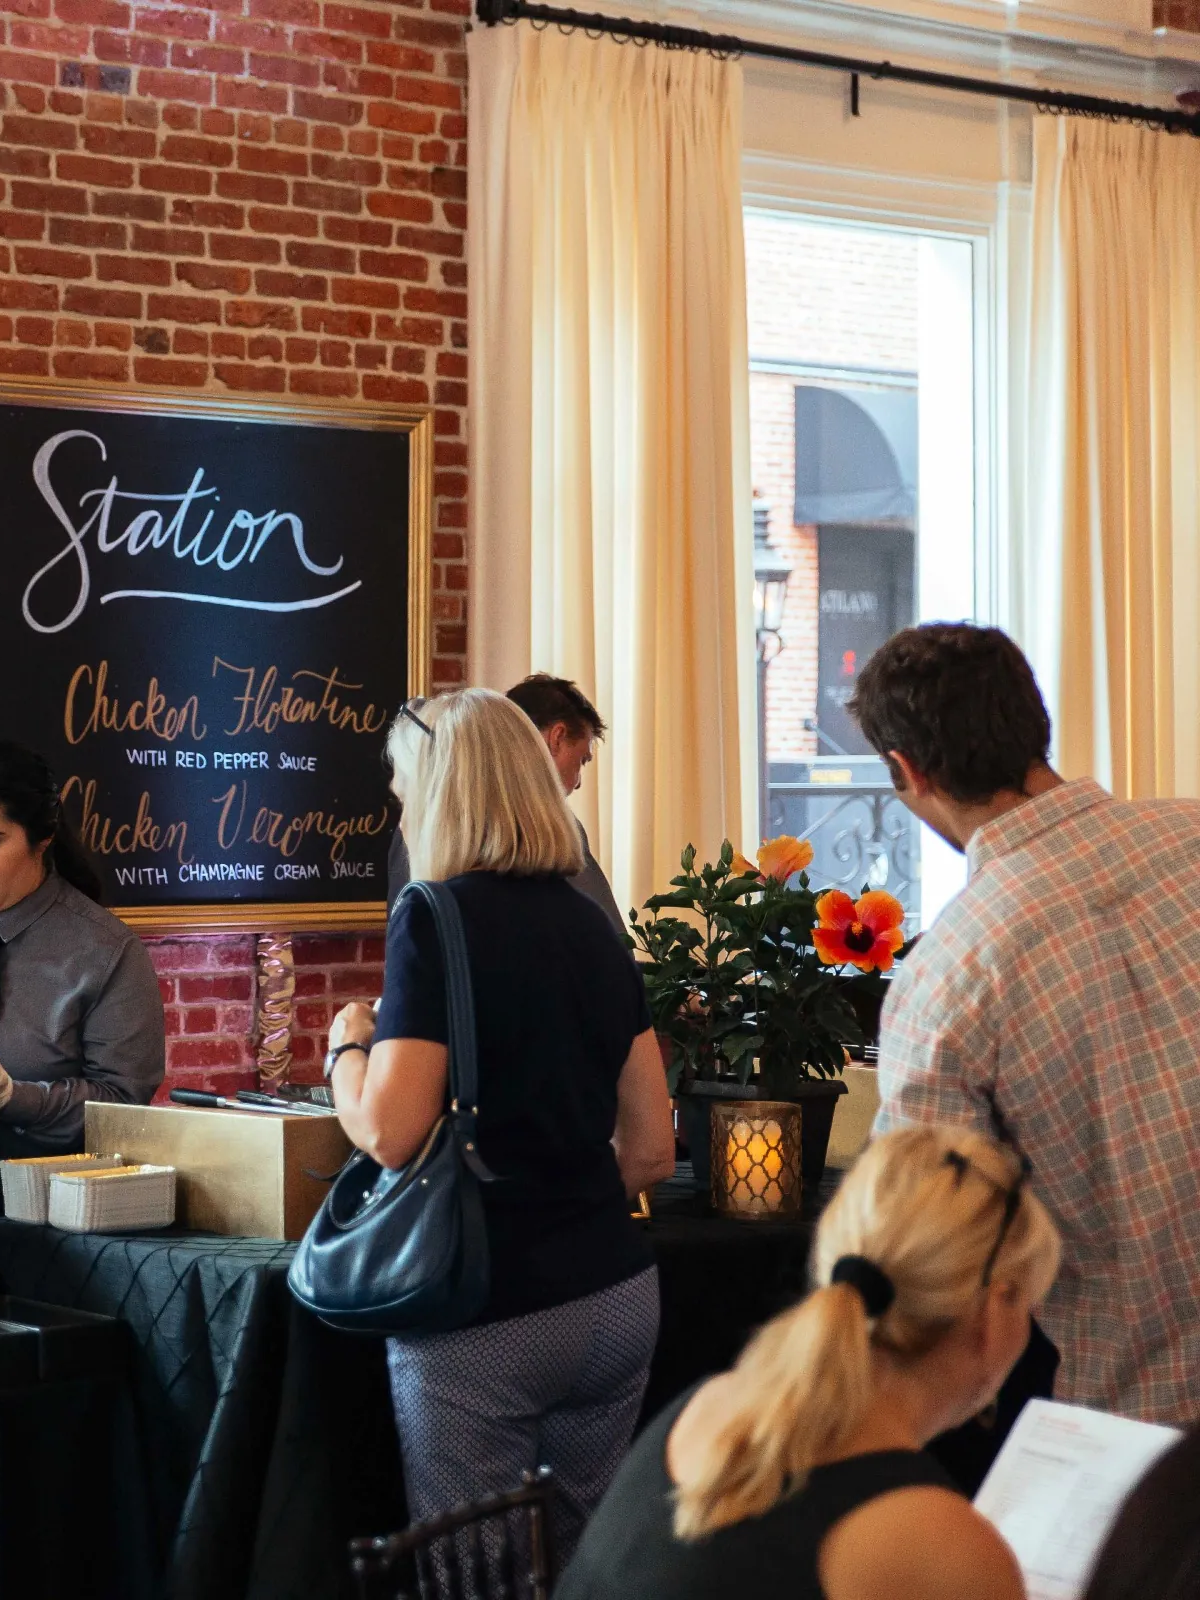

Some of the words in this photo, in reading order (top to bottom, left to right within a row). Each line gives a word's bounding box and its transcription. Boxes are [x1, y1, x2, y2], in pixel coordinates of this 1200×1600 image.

[22, 429, 344, 633] Station
[64, 660, 207, 745] Chicken
[212, 655, 387, 737] Florentine
[126, 748, 167, 767] WITH
[175, 751, 207, 769] RED
[213, 752, 269, 770] PEPPER
[278, 753, 317, 772] SAUCE
[211, 780, 389, 862] Veronique
[115, 867, 168, 886] WITH
[179, 864, 265, 883] CHAMPAGNE
[274, 863, 320, 880] CREAM
[330, 861, 375, 878] SAUCE
